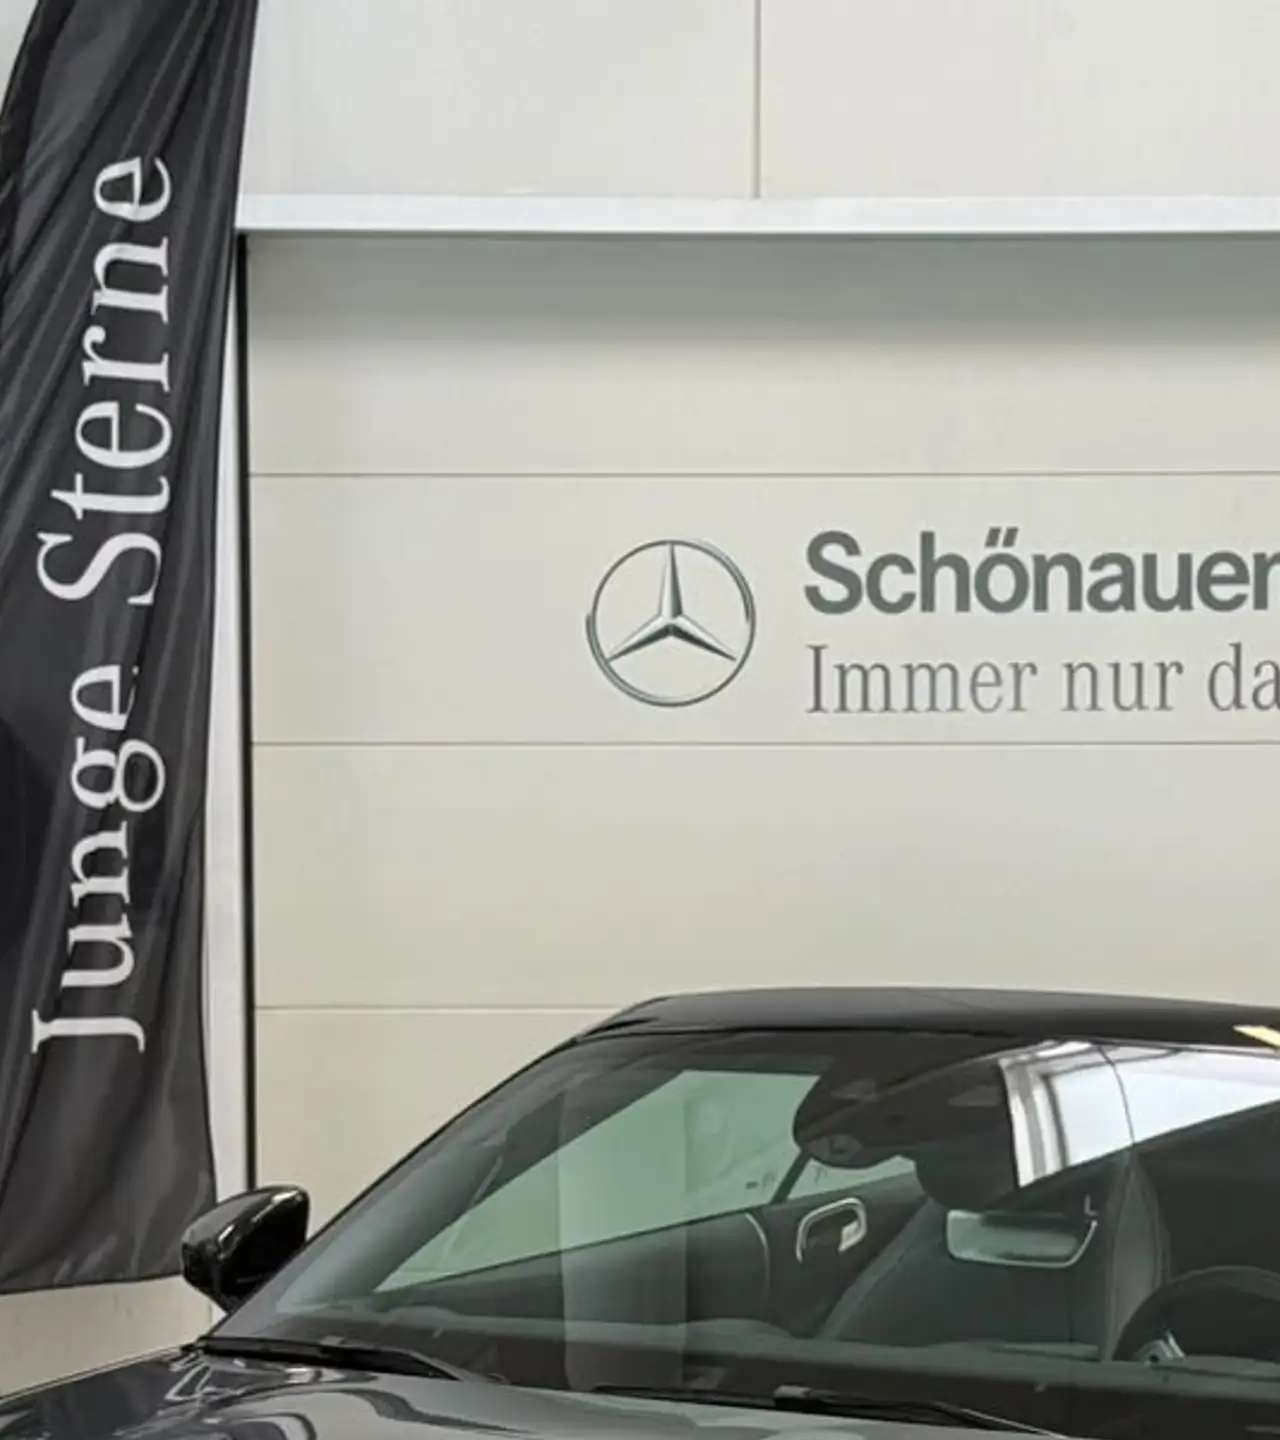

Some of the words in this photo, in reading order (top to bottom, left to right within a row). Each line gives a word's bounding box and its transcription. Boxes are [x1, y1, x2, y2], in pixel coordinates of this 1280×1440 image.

[36, 156, 172, 605] Sterne
[32, 664, 166, 1053] Junge
[806, 643, 1039, 715] Immer
[1062, 660, 1185, 713] nur
